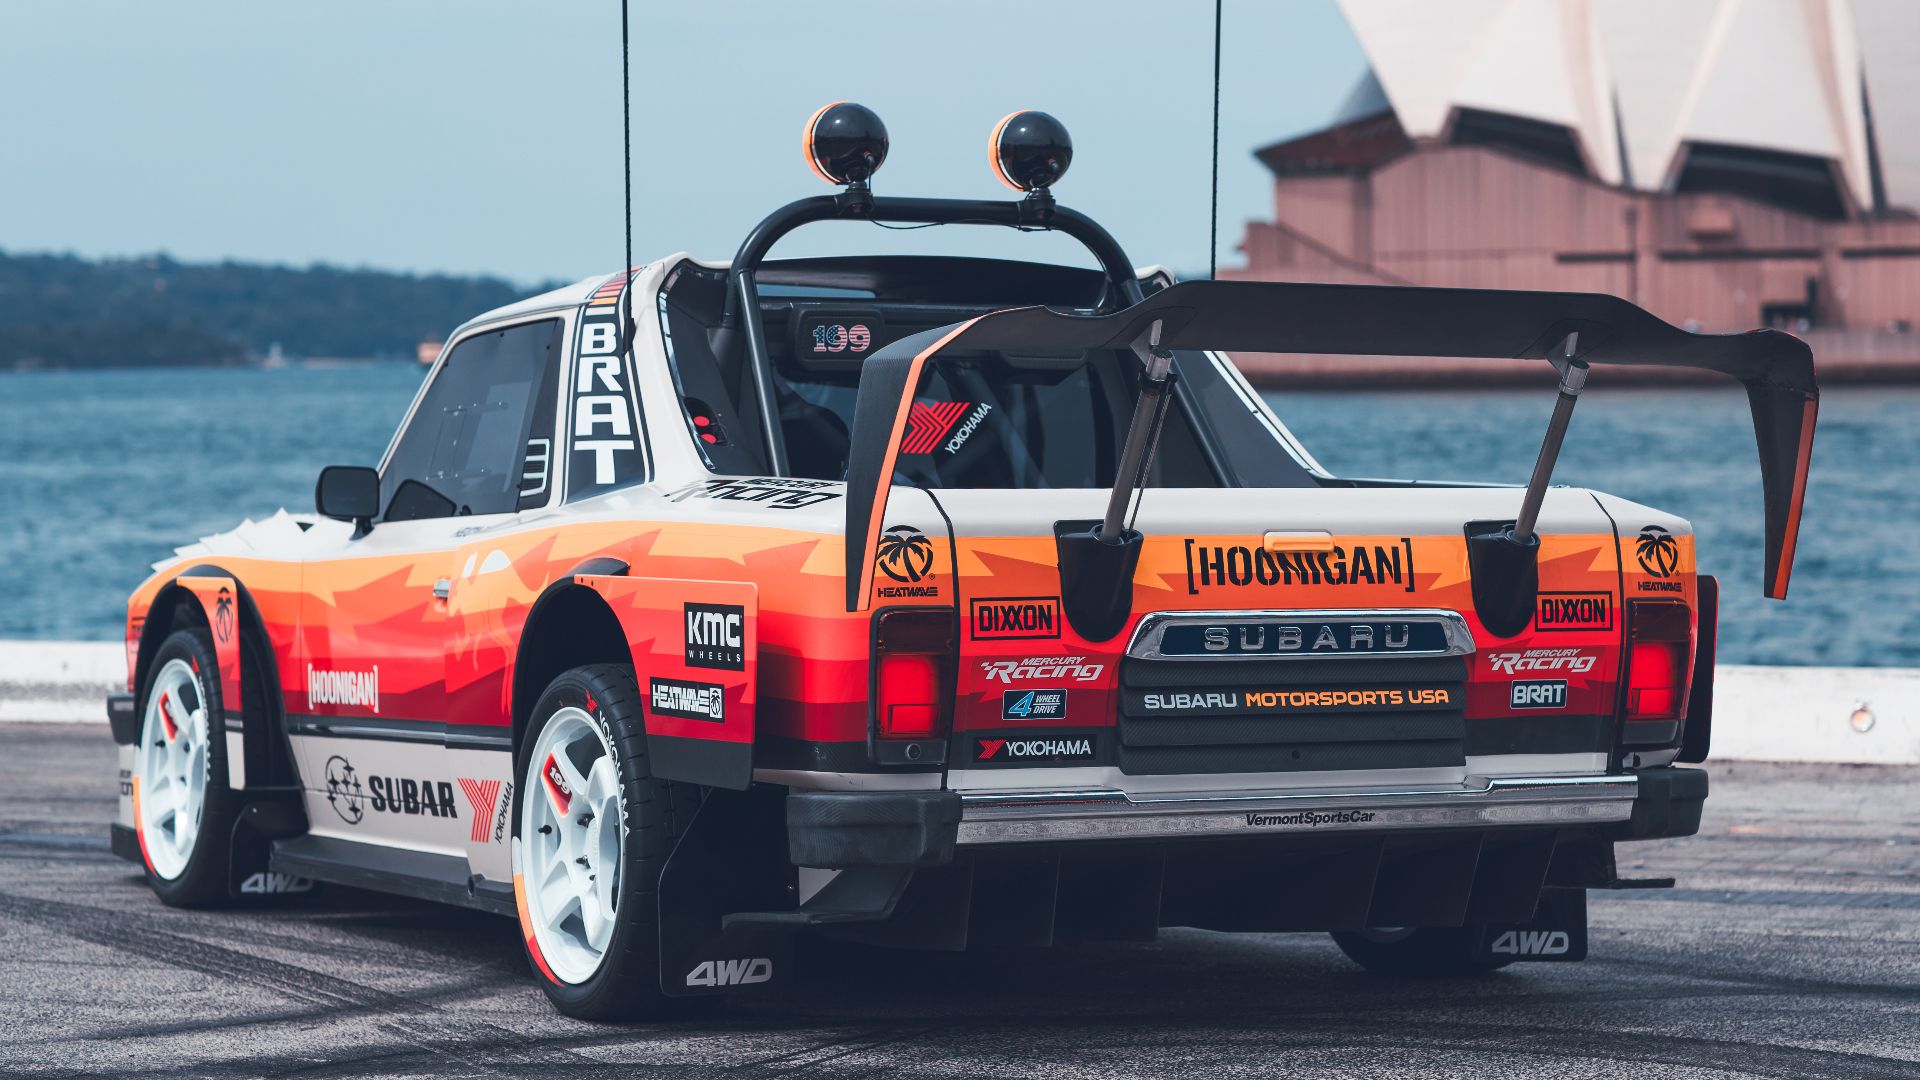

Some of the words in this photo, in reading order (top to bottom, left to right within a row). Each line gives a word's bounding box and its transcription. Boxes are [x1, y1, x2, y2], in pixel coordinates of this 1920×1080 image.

[812, 324, 871, 352] 199
[574, 322, 635, 485] BRAT
[944, 402, 992, 454] YOKOHAMA
[877, 586, 938, 598] HEATWAVE
[1638, 581, 1683, 592] HEATWAVE
[979, 604, 1053, 632] DIXXON
[1541, 598, 1605, 623] DIXXON
[1204, 625, 1409, 650] SUBARU
[688, 649, 741, 662] WHEELS
[1020, 656, 1086, 666] MERCURY
[1522, 648, 1582, 657] MERCURY
[980, 661, 1105, 684] Racing
[1488, 653, 1597, 675] Racing
[652, 684, 710, 713] HEATWAVE
[1007, 691, 1036, 716] 4
[1034, 694, 1061, 703] WHEEL
[1144, 693, 1237, 709] SUBARU
[1245, 690, 1404, 707] MOTORSPORTS
[1408, 689, 1449, 704] USA
[1512, 684, 1565, 704] BRAT
[1032, 705, 1058, 714] DRIVE
[1005, 739, 1092, 756] YOKOHAMA
[494, 782, 514, 845] YOKOHAMA
[1246, 810, 1376, 827] VermontSportsCar
[241, 872, 314, 893] 4WD
[1492, 931, 1569, 954] 4WD
[686, 958, 772, 986] 4WD
